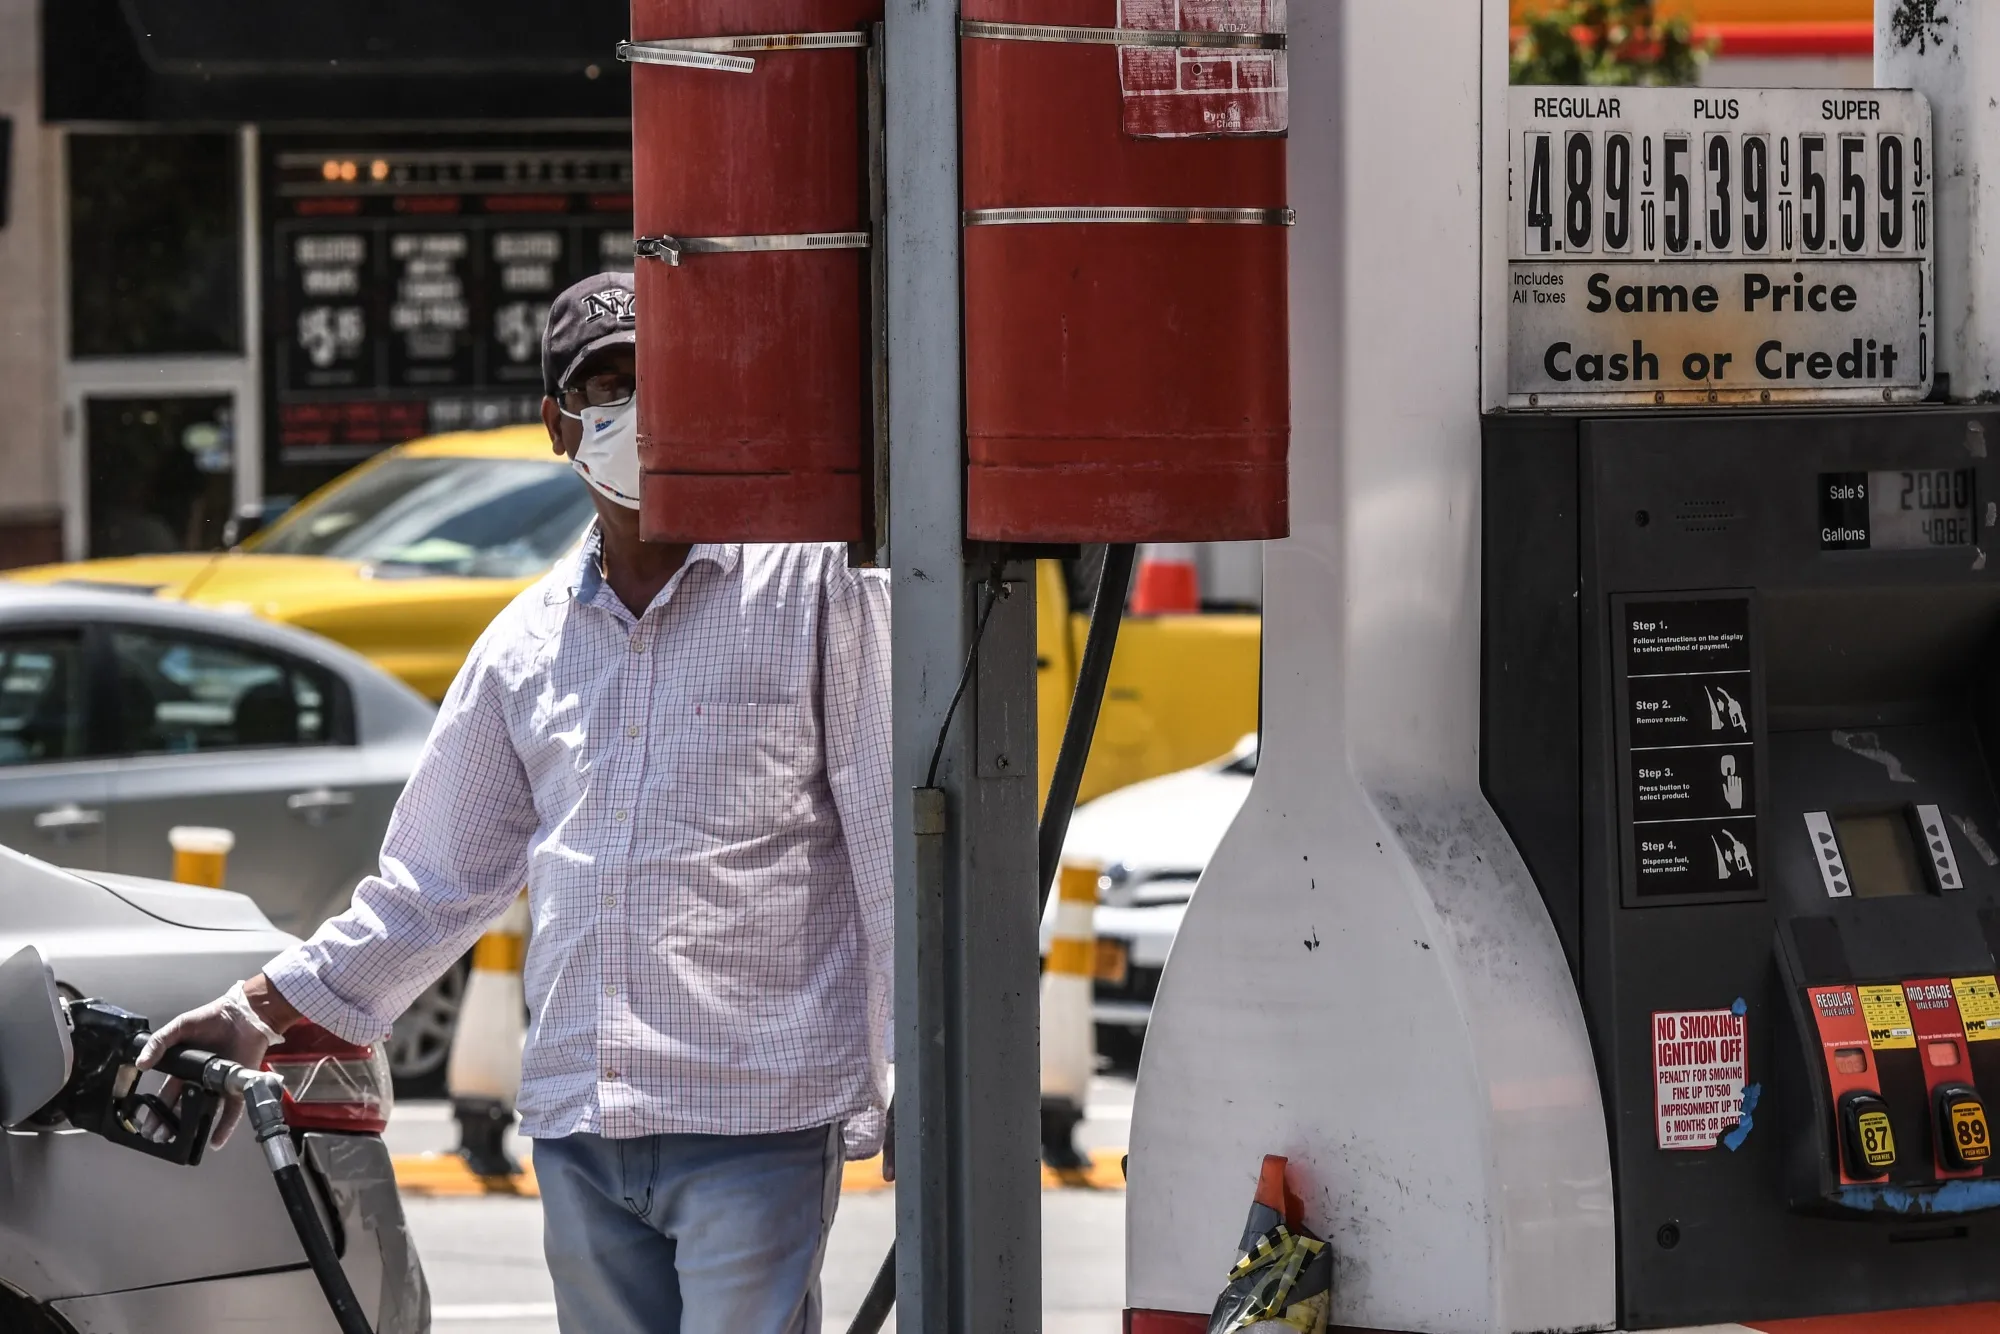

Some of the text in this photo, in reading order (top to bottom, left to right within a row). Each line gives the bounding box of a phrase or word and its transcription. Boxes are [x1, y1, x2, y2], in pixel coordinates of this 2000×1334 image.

[1533, 97, 1621, 119] REGULAR
[1693, 99, 1739, 120] PLUS
[1821, 99, 1880, 121] SUPER
[1203, 110, 1226, 122] Pyro
[1216, 119, 1241, 128] Chem
[1513, 272, 1564, 286] Includes
[1513, 291, 1566, 304] All Taxes
[1586, 272, 1857, 313] Same Price
[1544, 338, 1898, 382] Cash or Credit
[1830, 484, 1865, 499] Sale $
[1822, 527, 1866, 542] Gallons
[1632, 620, 1668, 632] Step 1.
[1633, 637, 1655, 645] Follow
[1720, 633, 1744, 641] display
[1642, 645, 1663, 653] select
[1699, 643, 1730, 651] payment.
[1636, 700, 1671, 711] Step 2.
[1664, 715, 1688, 723] nozzle.
[1638, 767, 1674, 779] Step 3.
[1662, 792, 1690, 800] product.
[1641, 840, 1677, 852] Step 4.
[1642, 858, 1673, 866] Dispense
[1664, 865, 1688, 873] nozzle.
[1815, 991, 1854, 1008] REGULAR
[1906, 984, 1953, 1002] MID-GRADE
[1916, 999, 1949, 1010] UNLEADED
[1821, 1007, 1855, 1017] UNLEADED
[1657, 1014, 1742, 1041] NO SMOKING
[1965, 1020, 1986, 1031] NYC
[1870, 1029, 1891, 1040] NYC
[1658, 1039, 1742, 1067] IGNITION OFF
[1659, 1066, 1743, 1085] PENALTY FOR SMOKING
[1672, 1086, 1690, 1100] FINE
[1691, 1085, 1703, 1099] UP
[1661, 1098, 1743, 1117] IMPRISONMENT UP TO
[1665, 1115, 1741, 1133] 6 MONTHS OR BOTH
[1864, 1126, 1888, 1152] 87
[1956, 1118, 1986, 1146] 89
